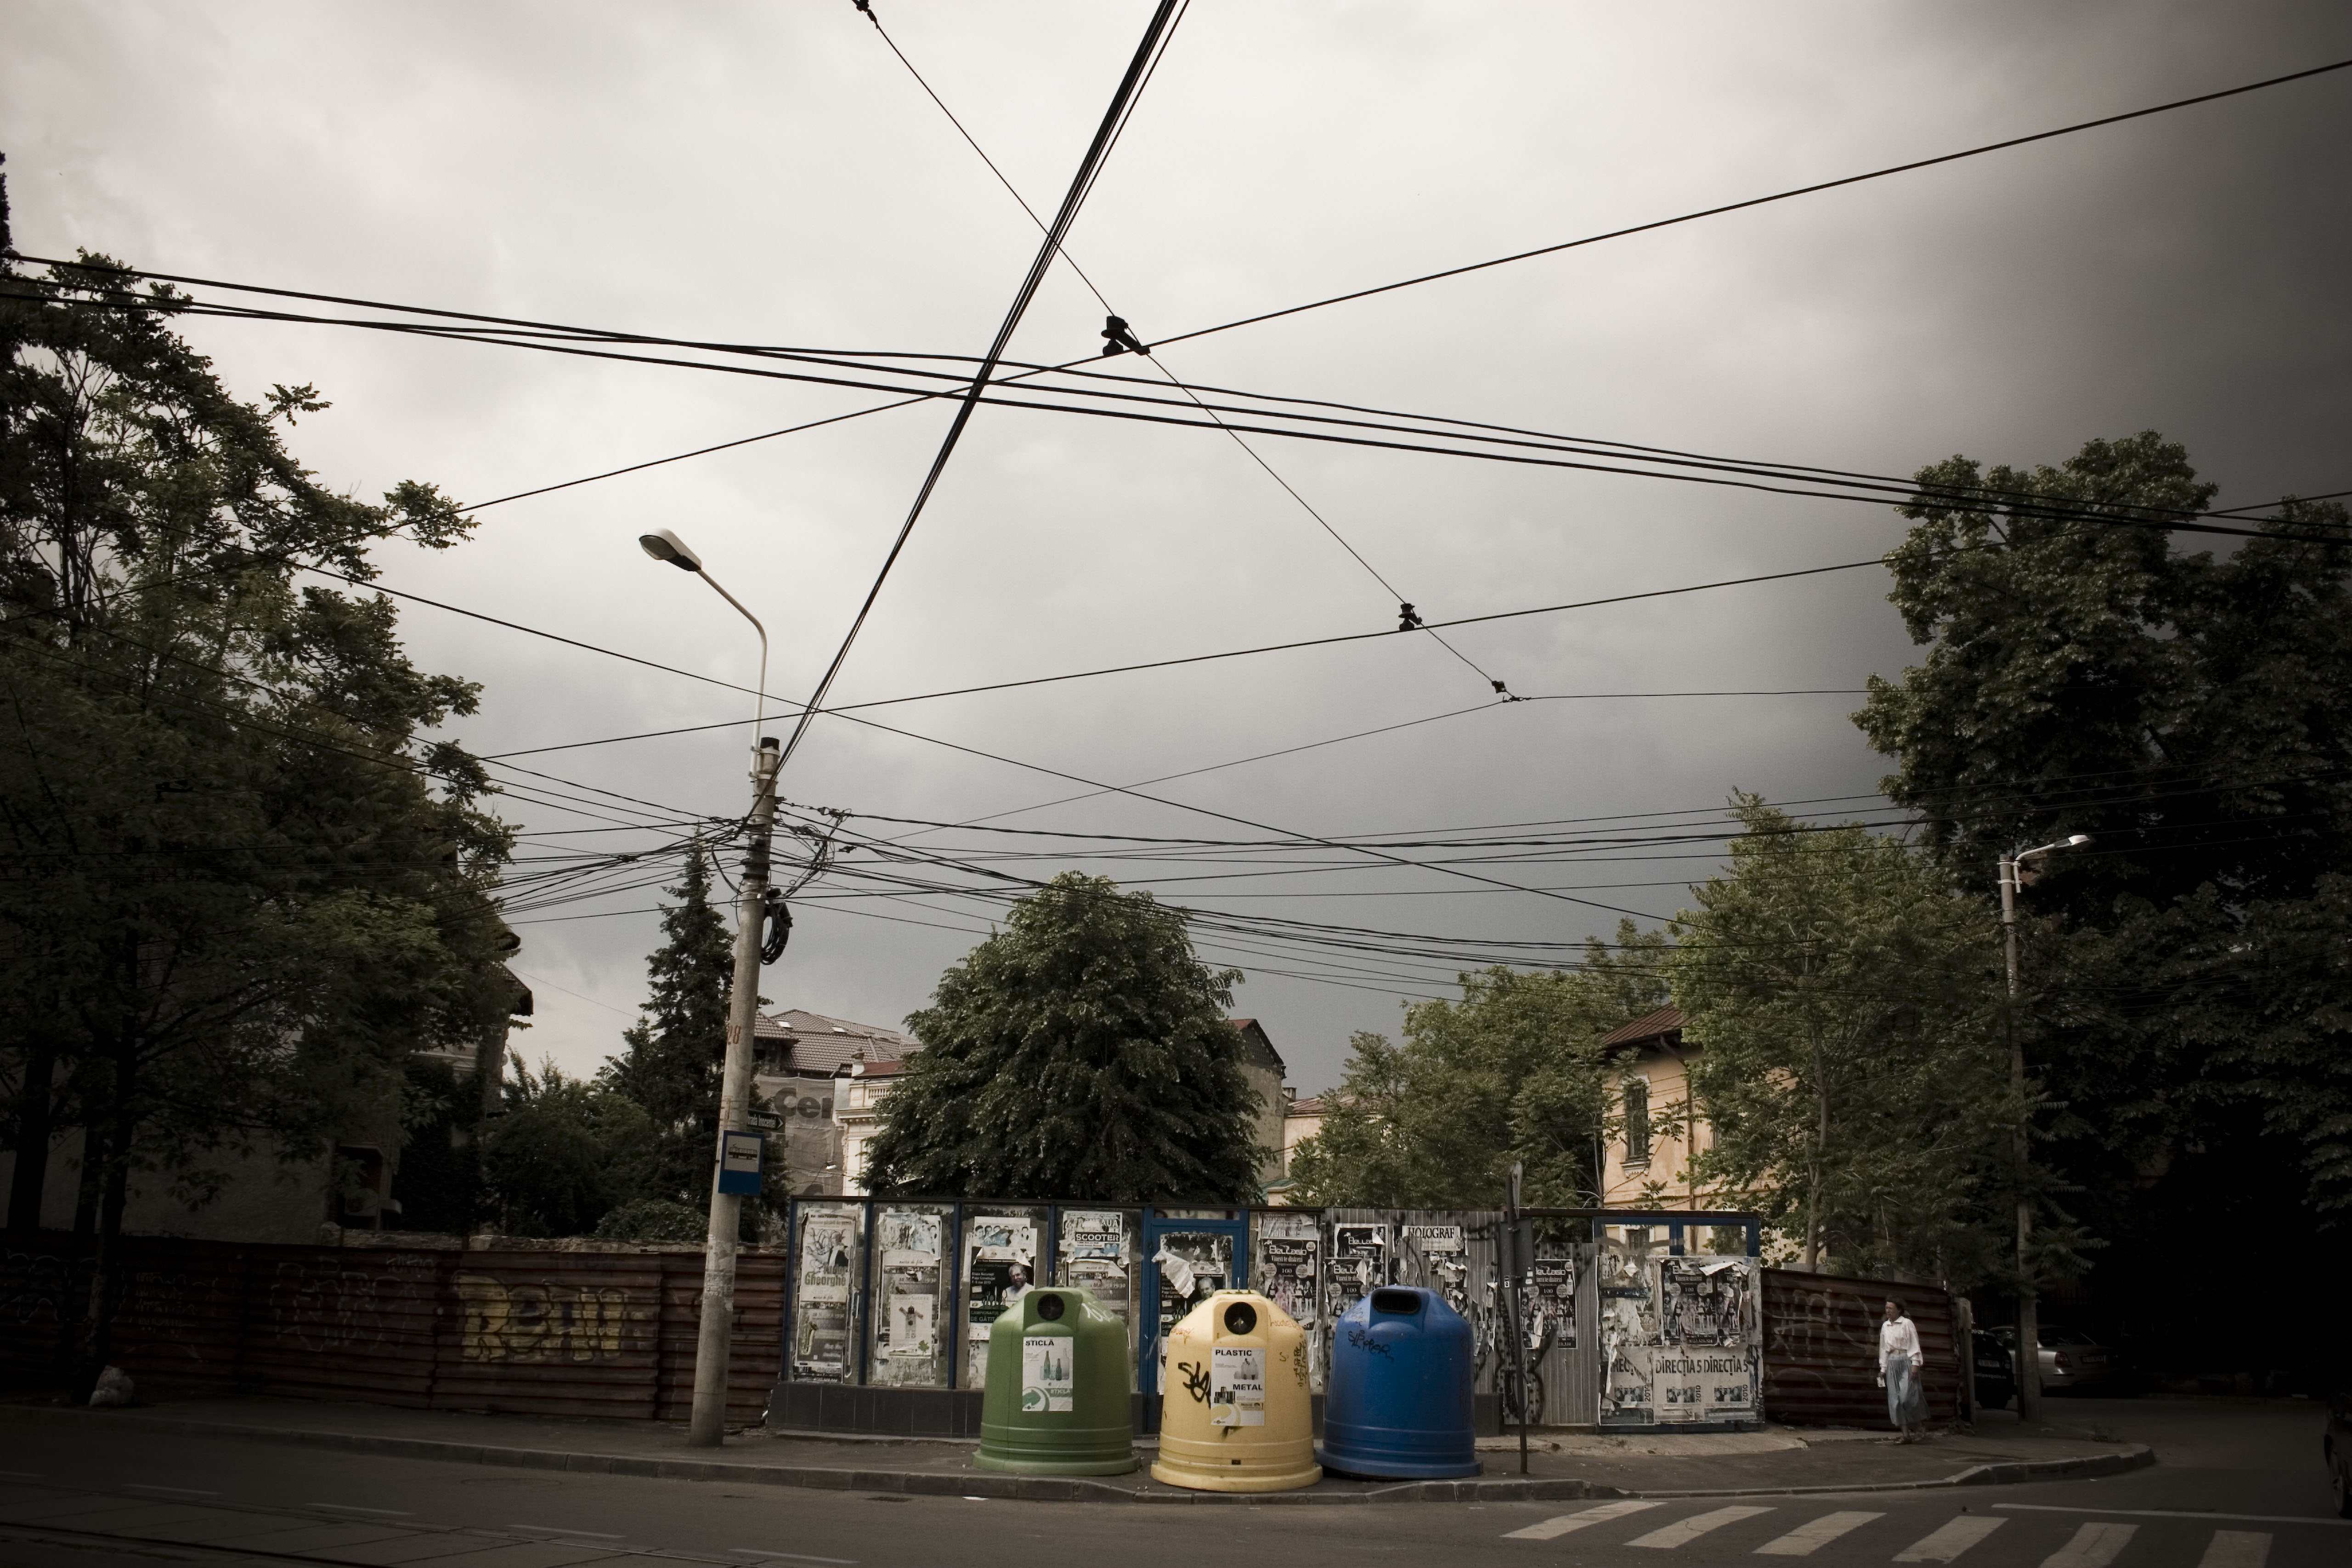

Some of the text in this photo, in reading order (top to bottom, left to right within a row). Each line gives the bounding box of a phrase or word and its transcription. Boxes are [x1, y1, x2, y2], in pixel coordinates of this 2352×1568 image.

[1075, 1233, 1119, 1241] SCOOTER
[1408, 1227, 1454, 1239] HOLOGRAF
[805, 1274, 846, 1286] Gheorghe
[1697, 1359, 1702, 1373] 5
